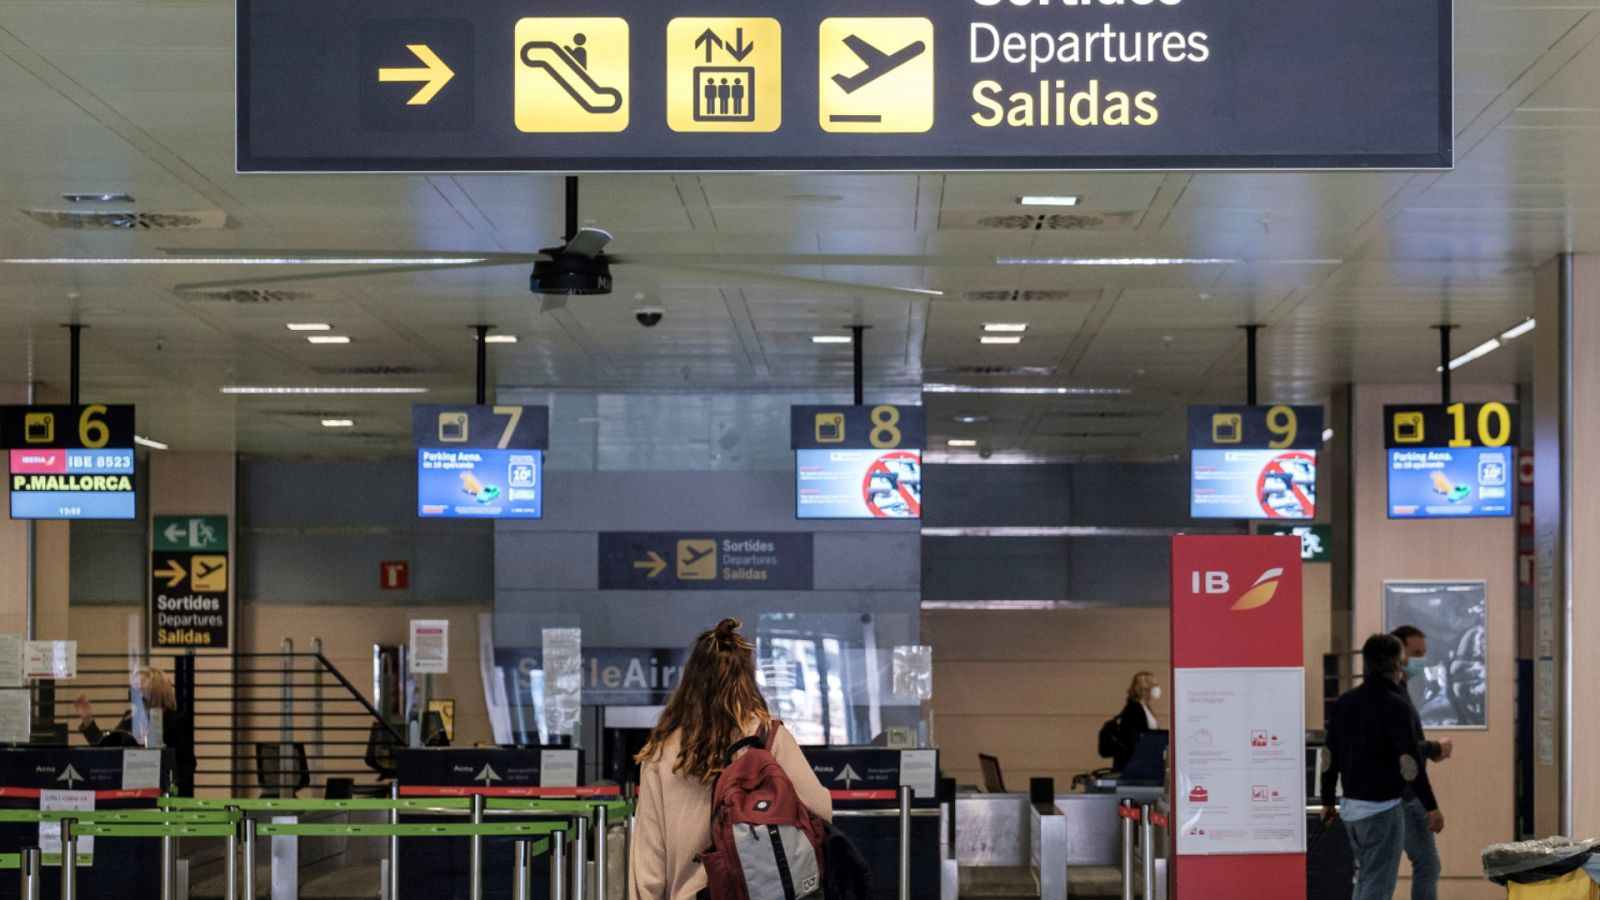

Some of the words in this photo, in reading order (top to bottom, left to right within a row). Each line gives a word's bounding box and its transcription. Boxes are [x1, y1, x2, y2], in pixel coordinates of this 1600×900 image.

[970, 22, 1209, 73] Departures
[971, 79, 1159, 127] Salidas
[79, 404, 110, 448] 6
[493, 405, 523, 448] 7
[869, 405, 901, 449] 8
[1266, 405, 1298, 449] 9
[1446, 401, 1511, 448] 10
[69, 456, 93, 468] IBE
[96, 456, 131, 468] 8523
[423, 451, 457, 463] Parking
[1393, 451, 1427, 463] Parking
[14, 475, 132, 491] P.MALLORCA
[722, 539, 775, 552] Sortides
[722, 554, 778, 566] Departures
[722, 567, 768, 580] Salidas
[1191, 570, 1230, 594] IB
[157, 594, 220, 611] Sortides
[158, 612, 223, 628] Departures
[157, 628, 212, 645] Salidas
